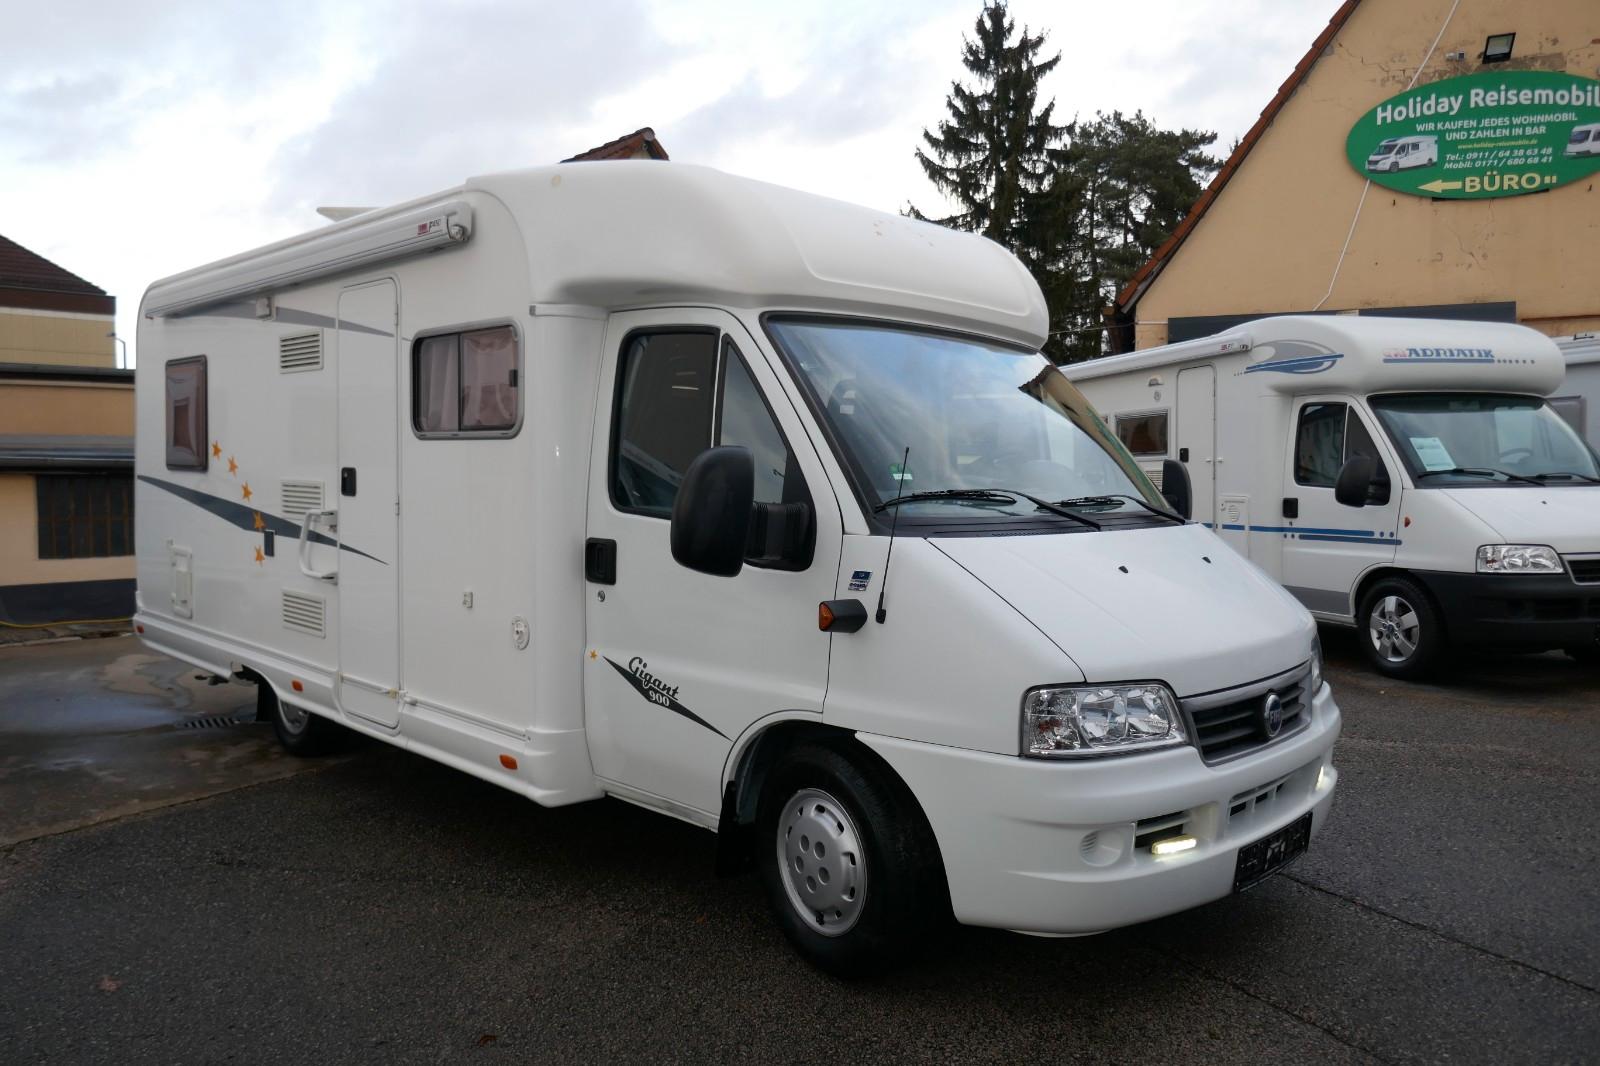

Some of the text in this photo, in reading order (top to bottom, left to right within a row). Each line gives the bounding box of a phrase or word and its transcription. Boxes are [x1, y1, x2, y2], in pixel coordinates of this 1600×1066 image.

[1376, 93, 1463, 125] Holiday
[1416, 112, 1578, 132] WIR KAUFEN JEDES WOHNMOBIL
[1446, 125, 1547, 141] UND ZAHLEN IN BAR
[1444, 161, 1473, 169] Mobil:
[1475, 159, 1498, 168] 0171
[1446, 153, 1464, 161] Tel.:
[1466, 151, 1489, 160] 0911
[1464, 171, 1541, 193] BÜRO
[628, 656, 680, 701] Gigant
[649, 690, 670, 707] 900
